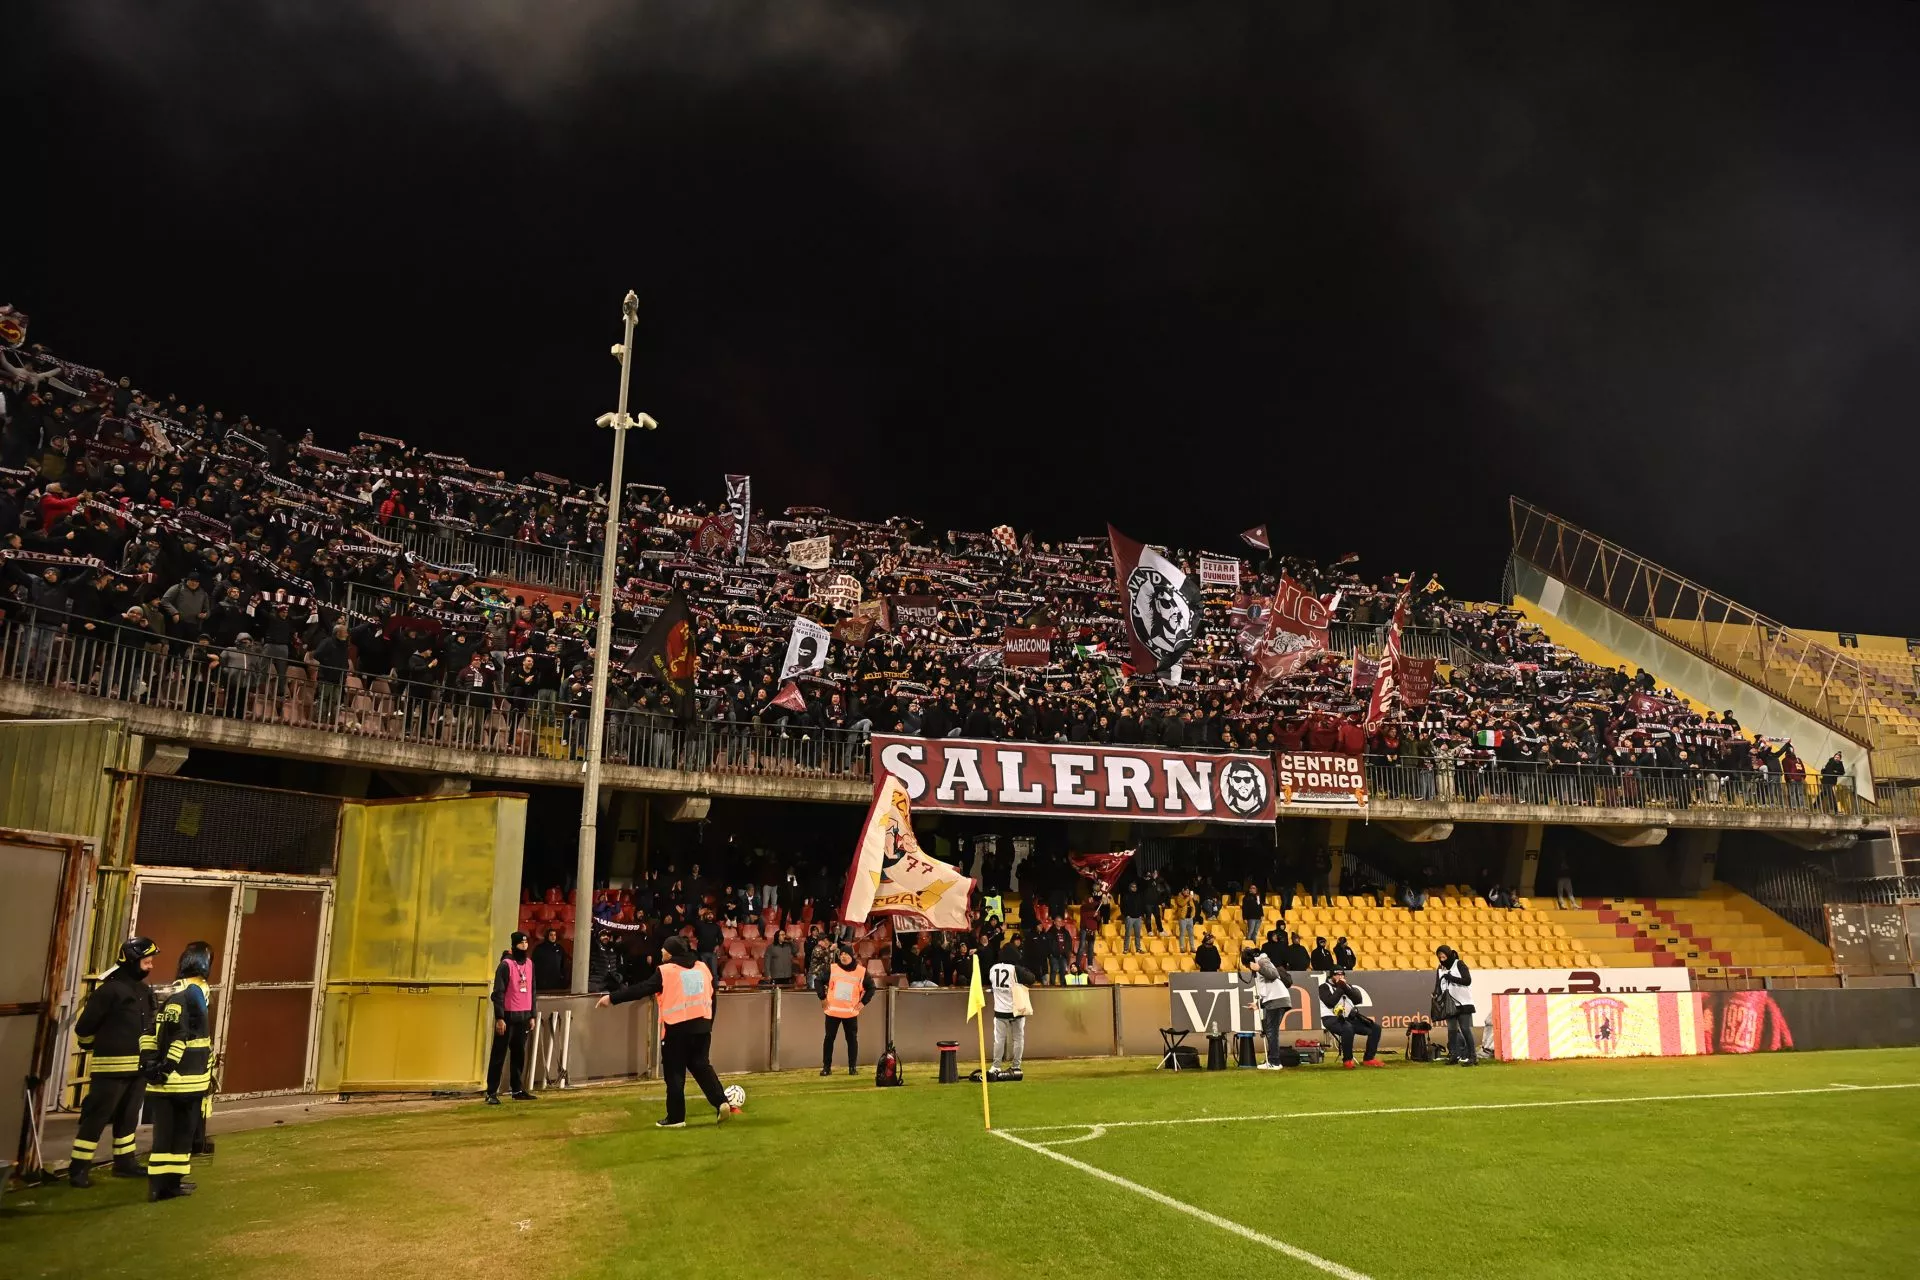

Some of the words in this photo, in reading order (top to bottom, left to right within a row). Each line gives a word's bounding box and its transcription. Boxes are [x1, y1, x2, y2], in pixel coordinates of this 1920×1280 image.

[1203, 562, 1236, 573] CETARA
[317, 599, 377, 625] SALERNO
[1006, 639, 1050, 653] MARICONDA
[1281, 754, 1359, 773] CENTRO
[1280, 771, 1364, 789] STORICO
[906, 855, 934, 875] 77
[994, 968, 1010, 988] 12
